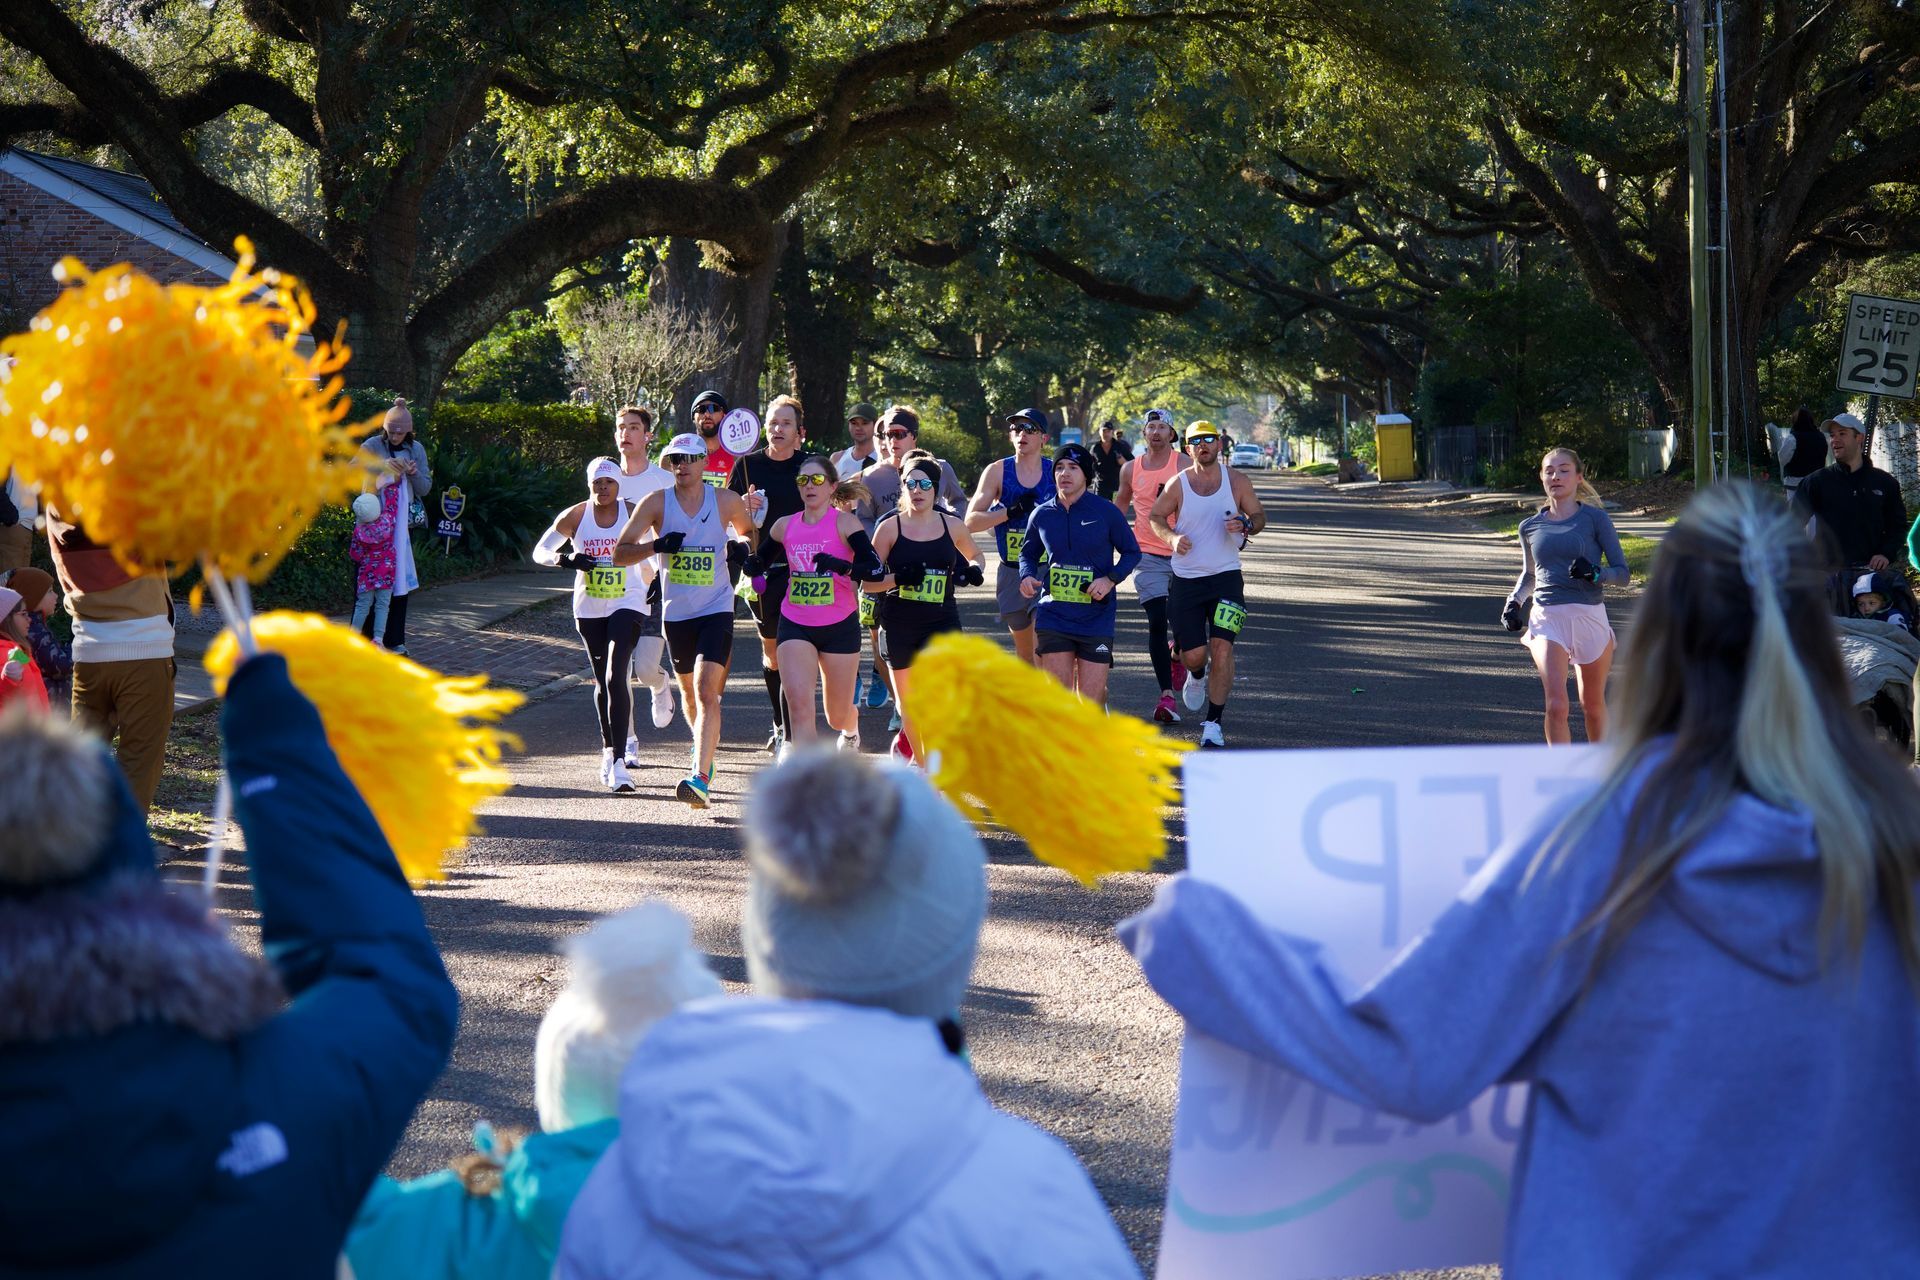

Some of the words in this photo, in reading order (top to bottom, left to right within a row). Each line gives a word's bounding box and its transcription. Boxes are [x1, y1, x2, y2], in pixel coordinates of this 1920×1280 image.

[1855, 304, 1920, 327] SPEED
[1859, 325, 1910, 346] LIMIT
[1847, 348, 1909, 388] 25
[729, 419, 751, 438] 3:10
[438, 520, 462, 532] 4514
[583, 538, 619, 547] NATION
[790, 543, 826, 552] VARSITY
[584, 546, 616, 556] GUA
[672, 555, 713, 571] 2389
[587, 570, 622, 585] 1751
[791, 581, 831, 598] 2622
